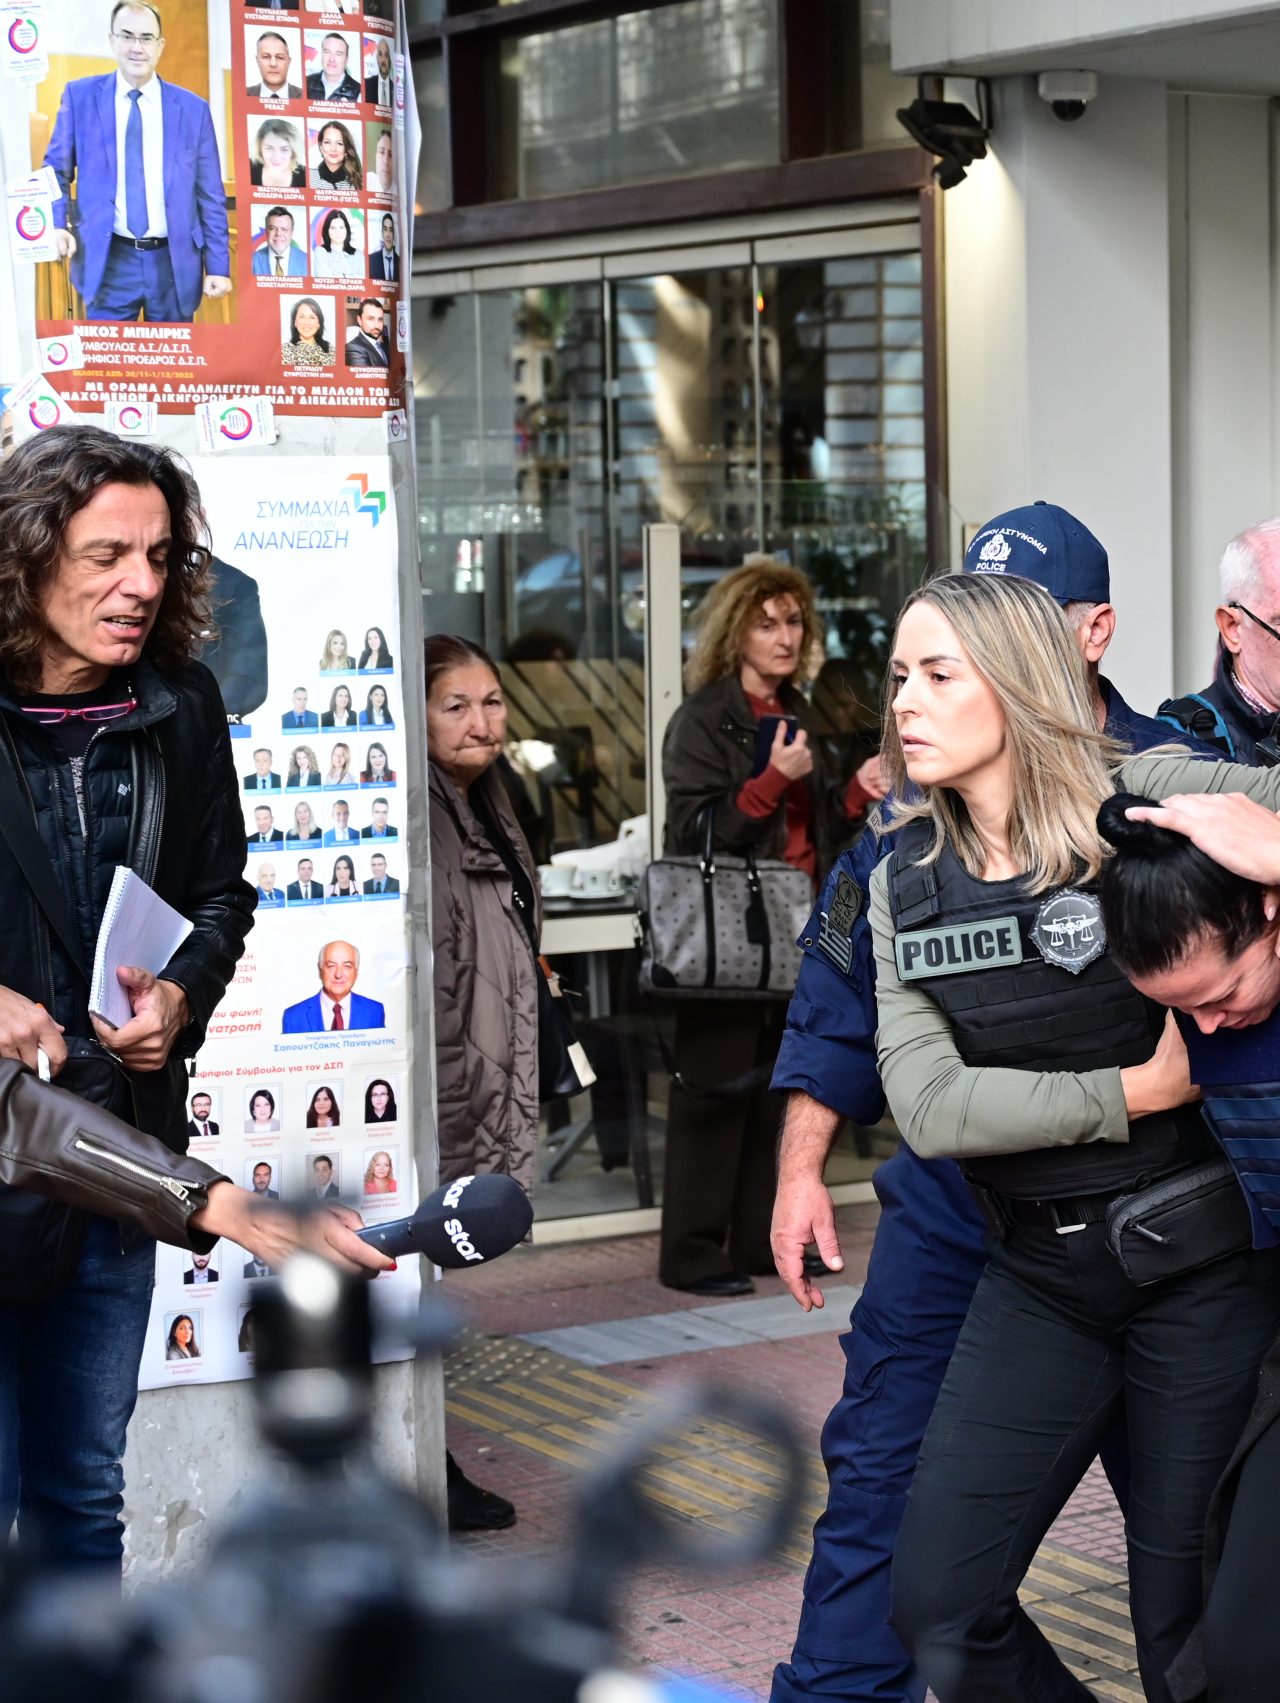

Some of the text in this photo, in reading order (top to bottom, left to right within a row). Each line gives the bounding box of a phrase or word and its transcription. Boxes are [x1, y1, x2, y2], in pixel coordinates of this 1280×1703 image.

[73, 325, 191, 340] ΝΙΚΟΣ ΜΠΙΛΙΡΗΣ
[81, 342, 136, 353] ΥΜΒΟΥΛΟΣ
[123, 354, 176, 365] ΠΡΟΕΔΡΟΣ
[178, 356, 208, 366] Δ.Σ.Π.
[85, 381, 104, 391] ΜΕ
[109, 382, 158, 393] ΟΡΑΜΑ
[163, 383, 172, 393] &
[178, 384, 260, 394] ΑΛΛΗΛΕΓΓΥΗ
[265, 385, 285, 395] ΓΙΑ
[290, 386, 306, 395] ΤΟ
[312, 386, 364, 396] ΜΕΛΛΟΝ
[299, 396, 386, 407] ΔΙΕΚΔΙΚΗΤΙΚΟ
[256, 500, 350, 518] ΣΥΜΜΑΧΙΑ
[234, 529, 349, 551] ΑΝΑΝΕΩΣΗ
[998, 528, 1048, 555] ΑΣΤΥΝΟΜΙΑ
[975, 561, 1007, 572] POLICE
[901, 926, 1015, 972] POLICE
[229, 1007, 263, 1019] φωνή!
[208, 1020, 262, 1035] νατροπή
[273, 1037, 397, 1052] Σαπουντζάκης Παναγιώτης
[235, 1066, 286, 1077] Σύμβουλοι
[288, 1065, 303, 1074] για
[305, 1064, 321, 1072] τον
[323, 1061, 344, 1070] ΔΣΠ
[444, 1218, 485, 1261] star
